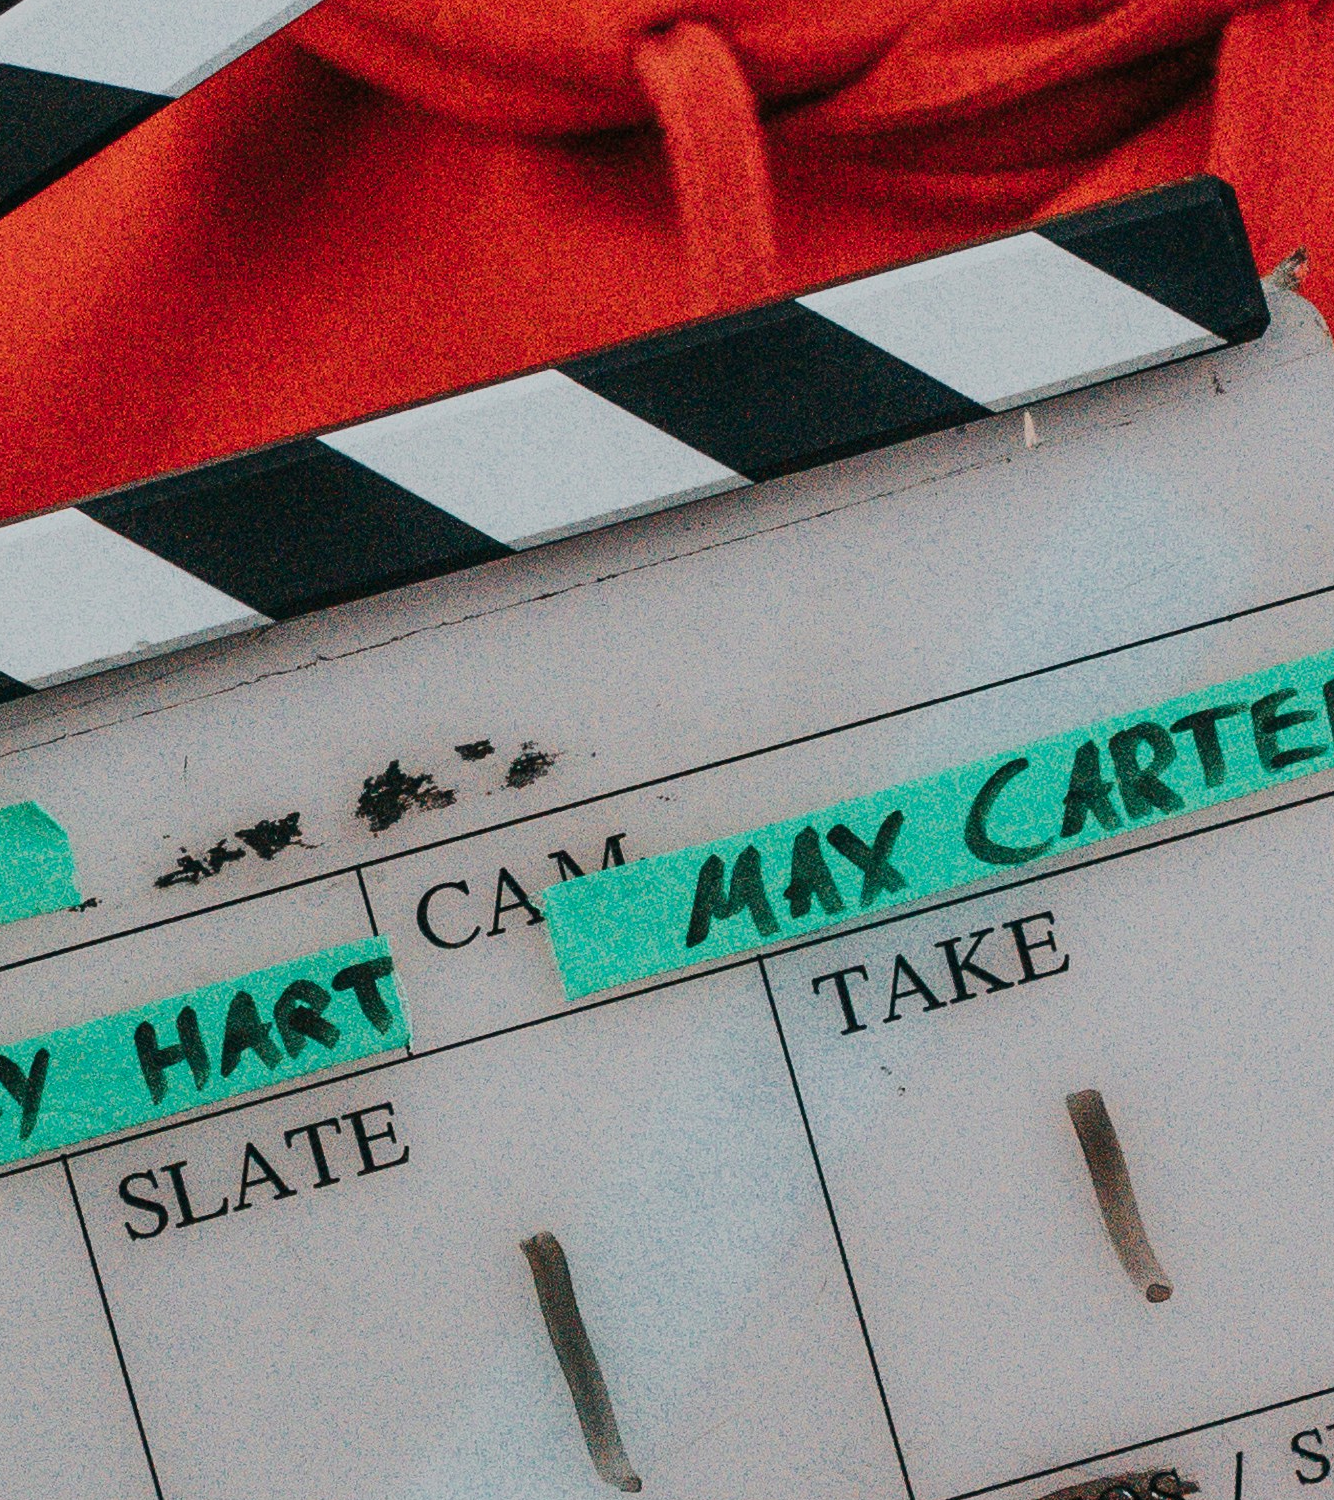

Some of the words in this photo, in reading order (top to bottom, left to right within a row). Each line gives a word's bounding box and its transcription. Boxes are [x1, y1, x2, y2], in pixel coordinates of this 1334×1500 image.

[683, 807, 908, 949] MAX
[134, 956, 393, 1105] HART
[812, 909, 1070, 1038] TAKE
[117, 1101, 411, 1242] SLATE
